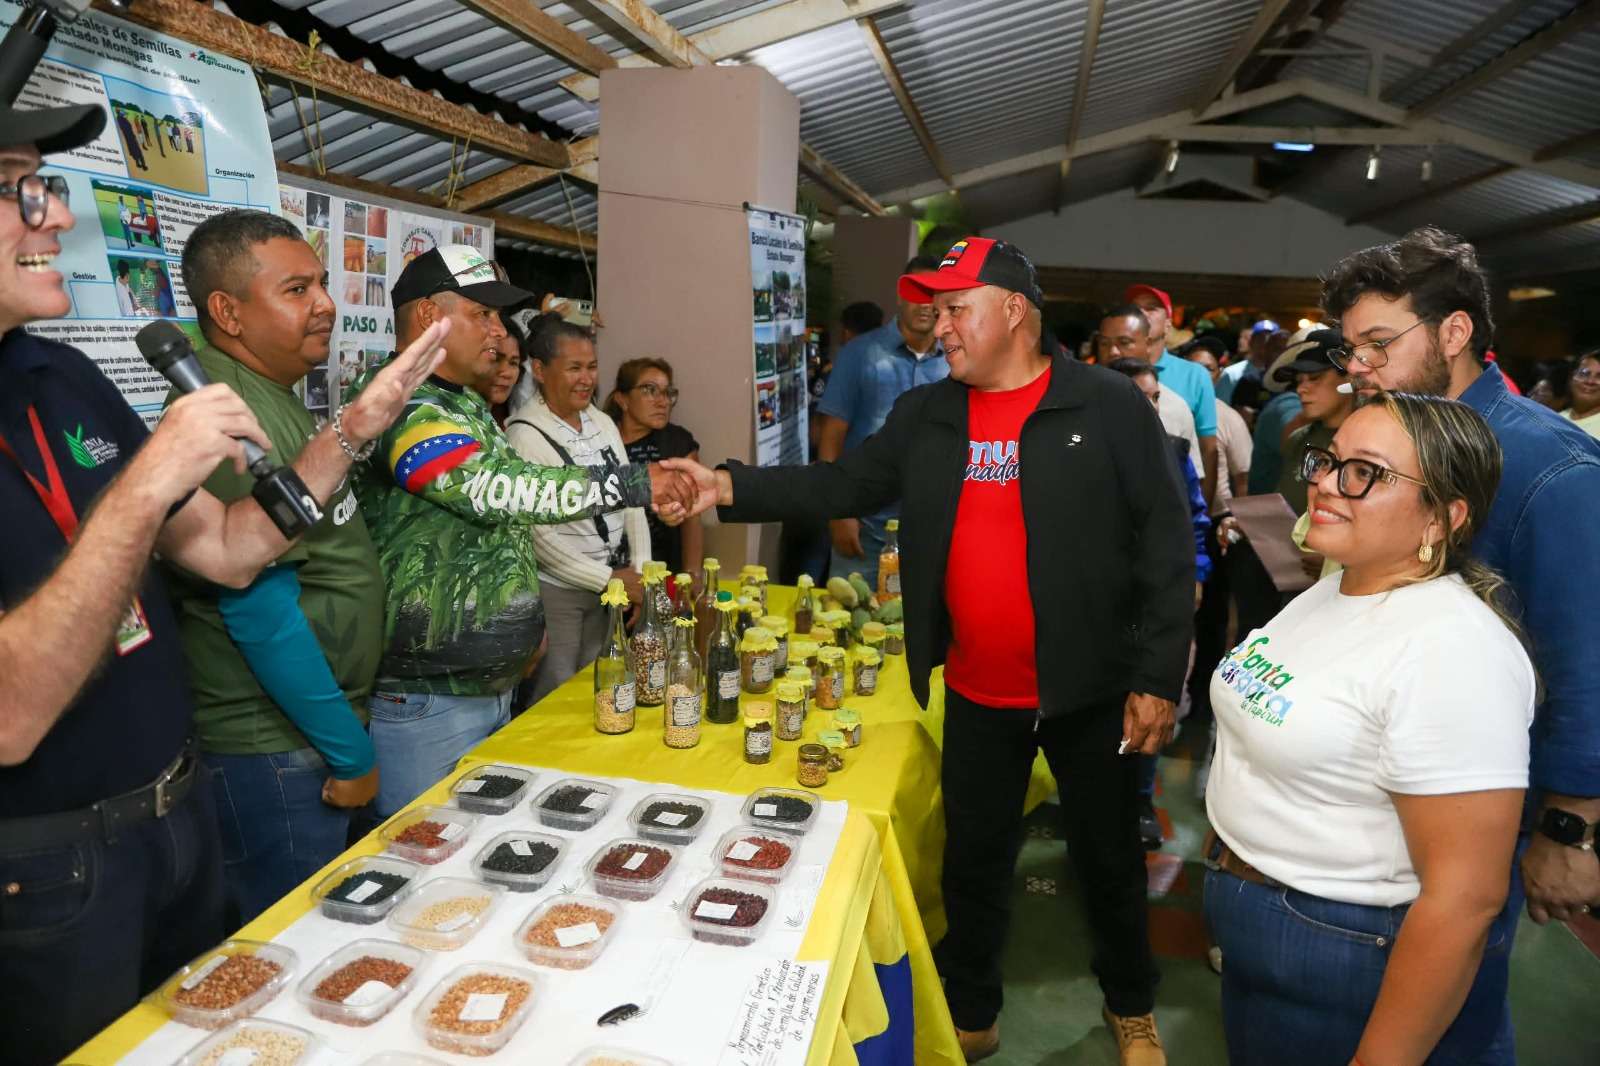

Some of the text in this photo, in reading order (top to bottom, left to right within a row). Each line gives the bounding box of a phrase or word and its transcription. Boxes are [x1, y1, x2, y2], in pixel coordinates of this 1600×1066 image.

[57, 23, 153, 64] Estado Monagas
[112, 26, 127, 42] de
[130, 30, 183, 60] Semillas
[343, 315, 394, 334] PASO A
[462, 466, 624, 517] MONAGAS
[1232, 636, 1294, 692] Santa
